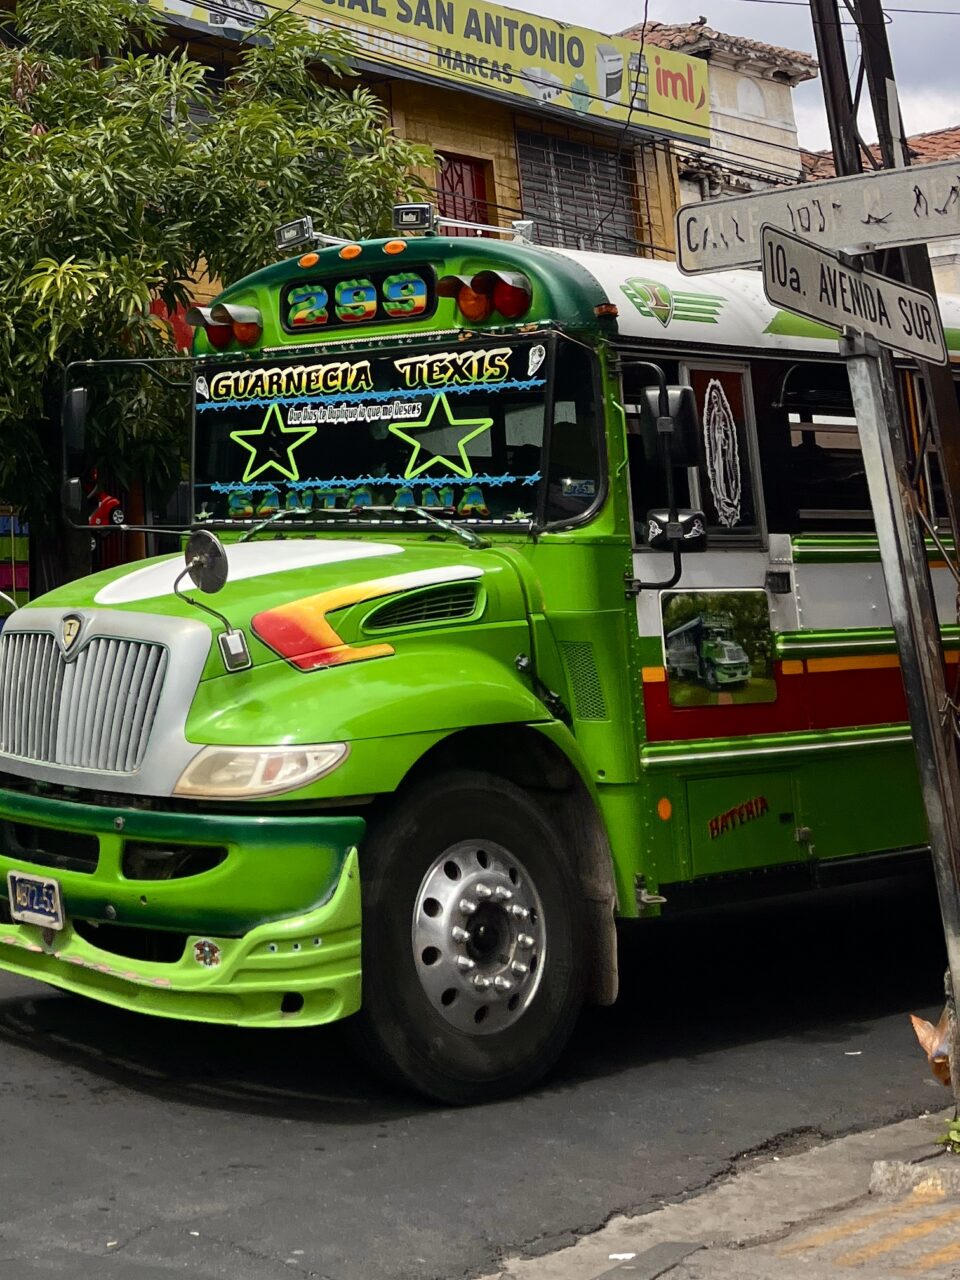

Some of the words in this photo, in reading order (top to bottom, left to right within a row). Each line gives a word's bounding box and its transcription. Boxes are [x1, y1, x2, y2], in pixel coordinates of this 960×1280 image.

[436, 45, 513, 85] MARCAS
[463, 7, 585, 69] ANTONIO
[286, 272, 428, 328] 299
[818, 262, 892, 330] AVENIDA
[896, 296, 937, 345] SUR
[210, 360, 374, 401] GUARNECIA
[394, 347, 513, 387] TEXIS
[227, 487, 375, 519] SANTA
[392, 485, 491, 517] ANA
